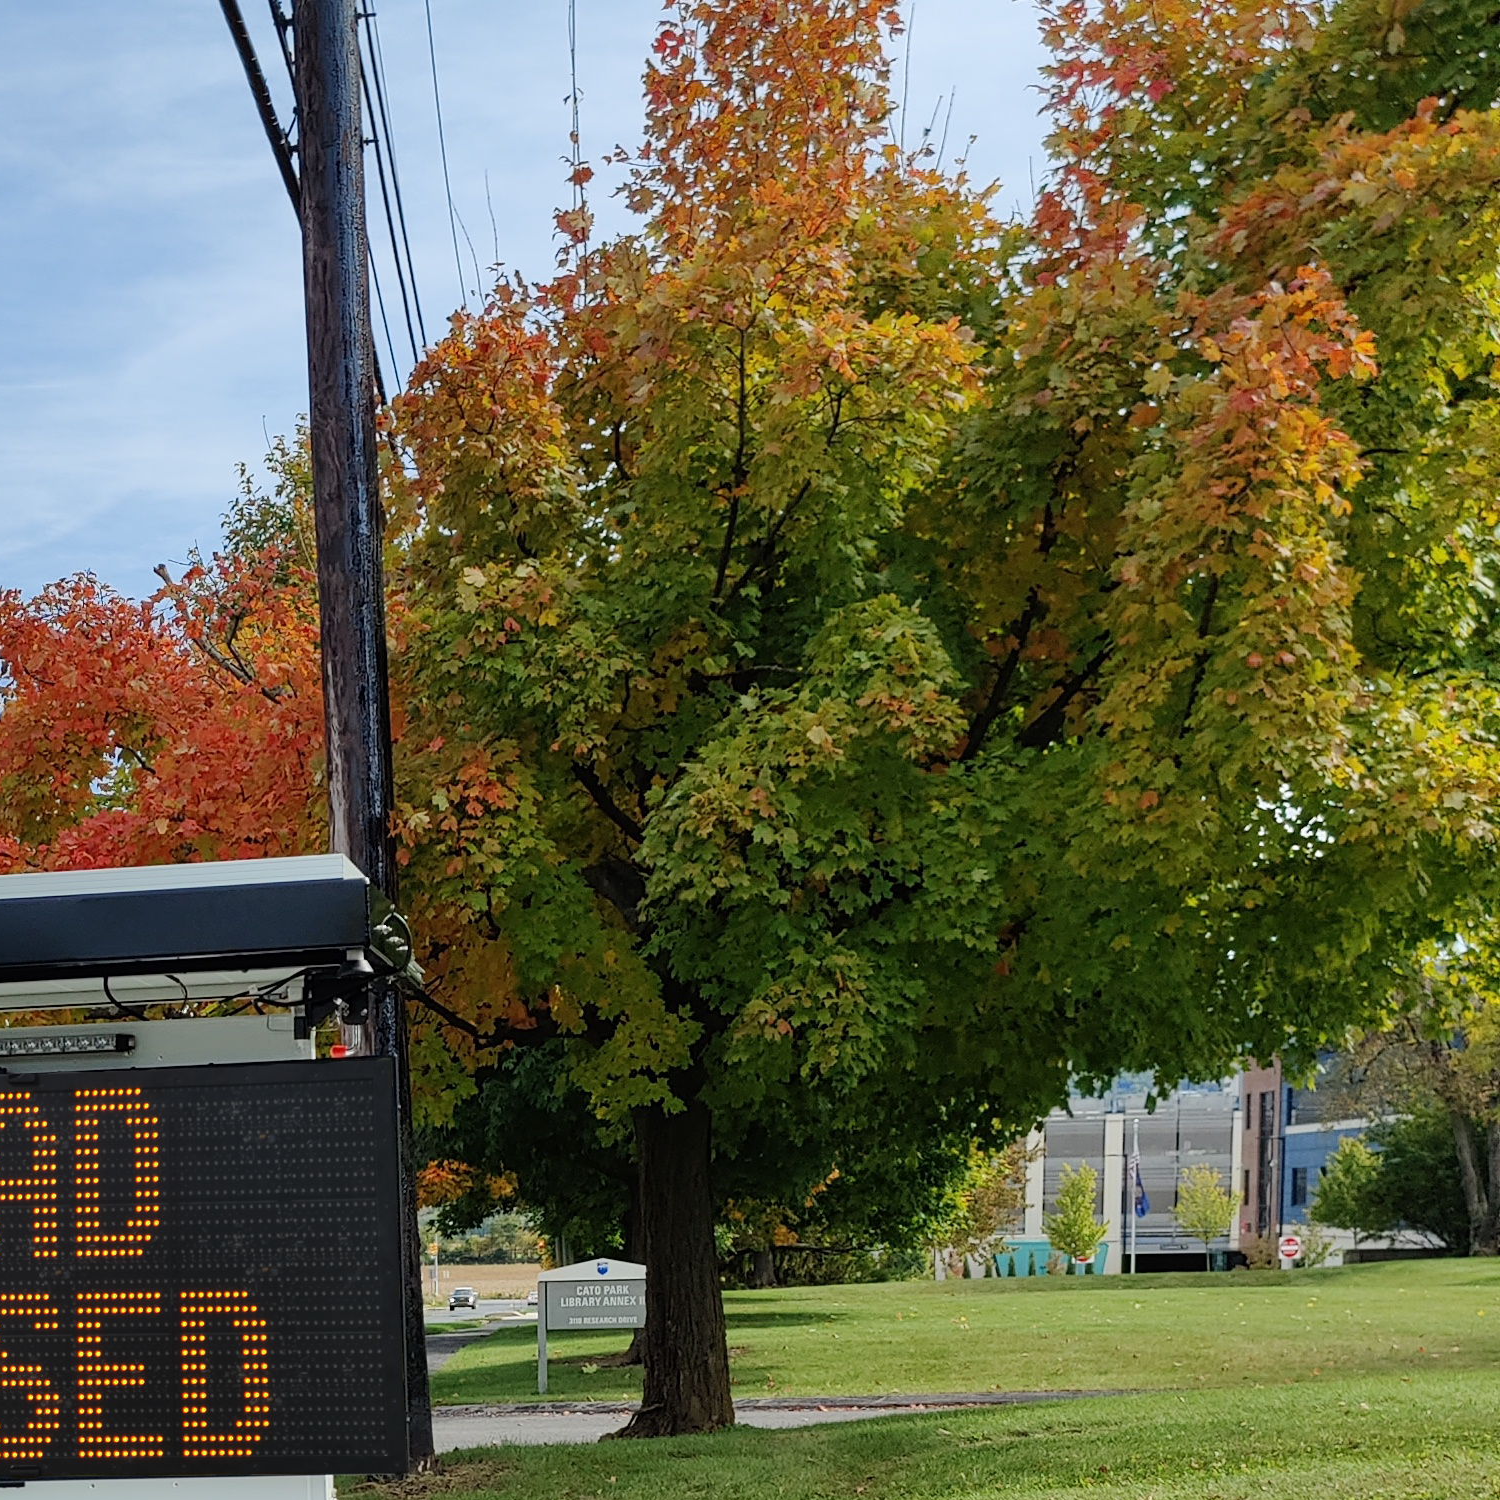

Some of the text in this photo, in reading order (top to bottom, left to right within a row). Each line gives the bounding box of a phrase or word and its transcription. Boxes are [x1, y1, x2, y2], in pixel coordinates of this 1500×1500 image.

[576, 1285, 629, 1296] CATO PARK
[560, 1297, 601, 1308] LIBRARY
[603, 1296, 636, 1307] ANNEX
[583, 1316, 617, 1325] RESEARCH
[618, 1316, 638, 1324] DRIVE
